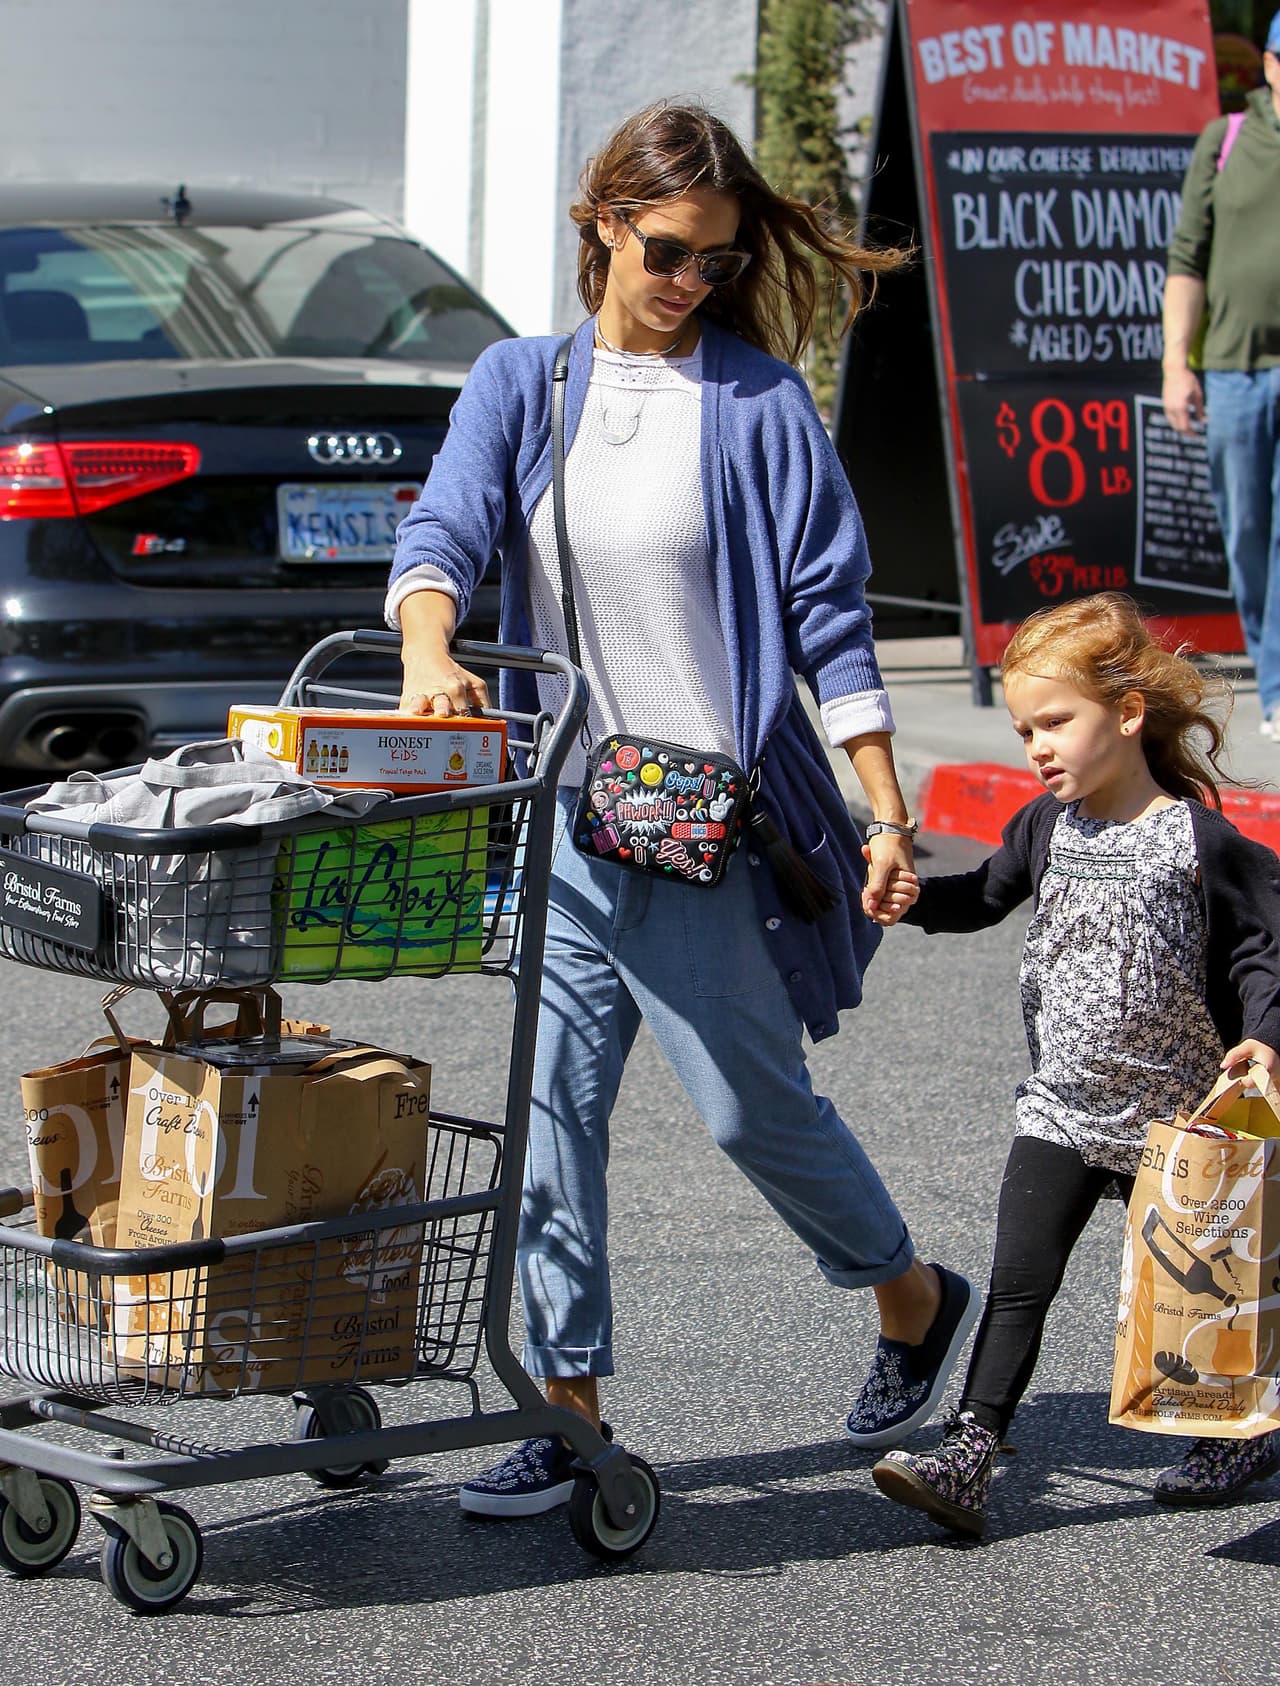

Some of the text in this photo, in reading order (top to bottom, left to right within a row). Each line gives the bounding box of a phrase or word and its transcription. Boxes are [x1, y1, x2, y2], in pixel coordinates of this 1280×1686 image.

[918, 21, 1206, 90] BEST OF MARKET
[987, 147, 1027, 173] OUR
[1029, 147, 1091, 173] CHEESE
[1099, 147, 1193, 172] DEPARTMEN
[952, 189, 1062, 250] BLACK
[1014, 259, 1166, 317] CHEDDAR
[1093, 324, 1113, 362] 5
[1100, 465, 1133, 496] LB
[992, 515, 1070, 575] Save
[378, 736, 432, 749] HONEST
[482, 735, 489, 748] 8
[665, 771, 706, 794] Oops!
[656, 838, 707, 879] Yes!
[4, 872, 82, 916] Bristol Farms
[5, 892, 18, 906] Your
[52, 910, 65, 922] Food
[64, 915, 80, 929] Store
[149, 1088, 181, 1105] Over
[393, 1093, 430, 1120] Fre
[146, 1106, 181, 1134] Craft
[1142, 1143, 1264, 1180] sh is Best
[142, 1180, 193, 1210] Farms
[1181, 1195, 1207, 1208] Over
[141, 1218, 168, 1235] Cheeses
[156, 1214, 172, 1224] 300
[1176, 1222, 1249, 1239] Selections
[1194, 1212, 1229, 1225] Wine
[128, 1228, 147, 1240] From
[149, 1234, 178, 1247] Around
[381, 1274, 410, 1293] food
[1153, 1302, 1222, 1320] Bristol Farms
[330, 1306, 400, 1341] Brstol
[1151, 1394, 1248, 1414] Baked Fresh Daily
[1153, 1386, 1235, 1399] Artisan Breads
[1132, 1408, 1224, 1422] BRISTOLFARMS.COM
